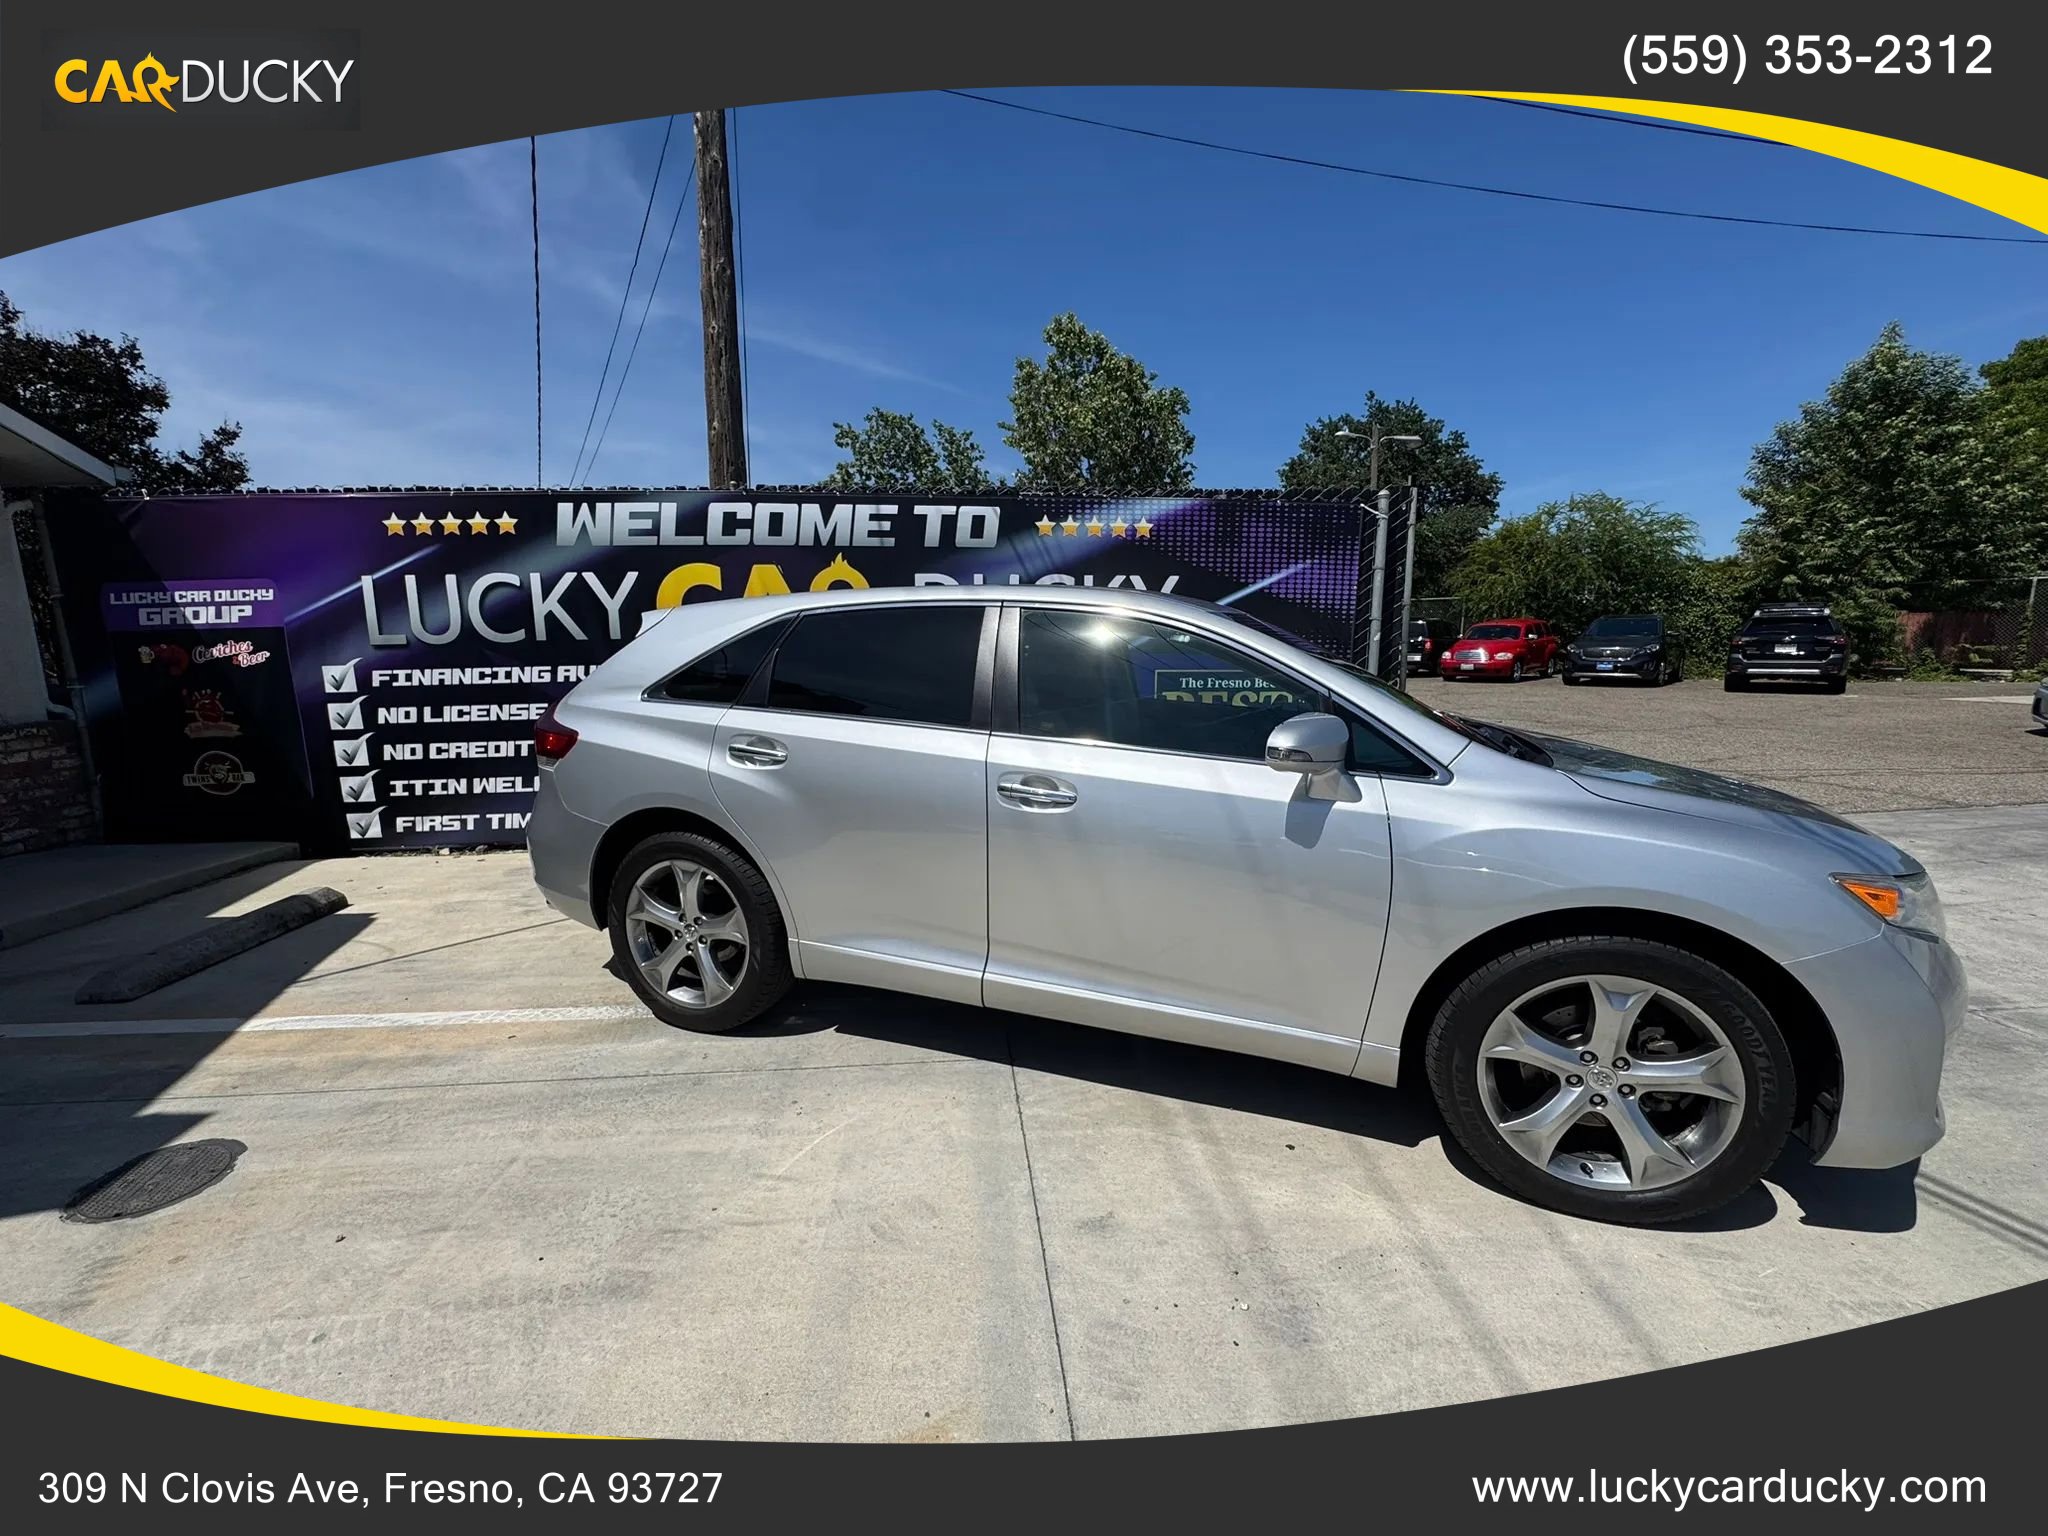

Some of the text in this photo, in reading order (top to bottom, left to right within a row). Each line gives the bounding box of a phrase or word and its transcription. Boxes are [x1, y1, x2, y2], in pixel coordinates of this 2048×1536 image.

[556, 502, 1001, 548] WELCOME TO
[109, 588, 274, 605] LUCKY CAR DUCKY
[138, 605, 253, 626] GROUP
[361, 571, 639, 645] LUCKY
[191, 639, 254, 664] Ceviches
[238, 651, 270, 667] Beer
[372, 665, 601, 687] FINANCING AV
[1179, 677, 1205, 689] The
[1207, 677, 1251, 689] Fresno
[378, 703, 548, 725] NO LICENSE
[383, 740, 534, 761] NO CREDIT
[389, 778, 468, 797] ITIN
[396, 814, 480, 833] FIRST
